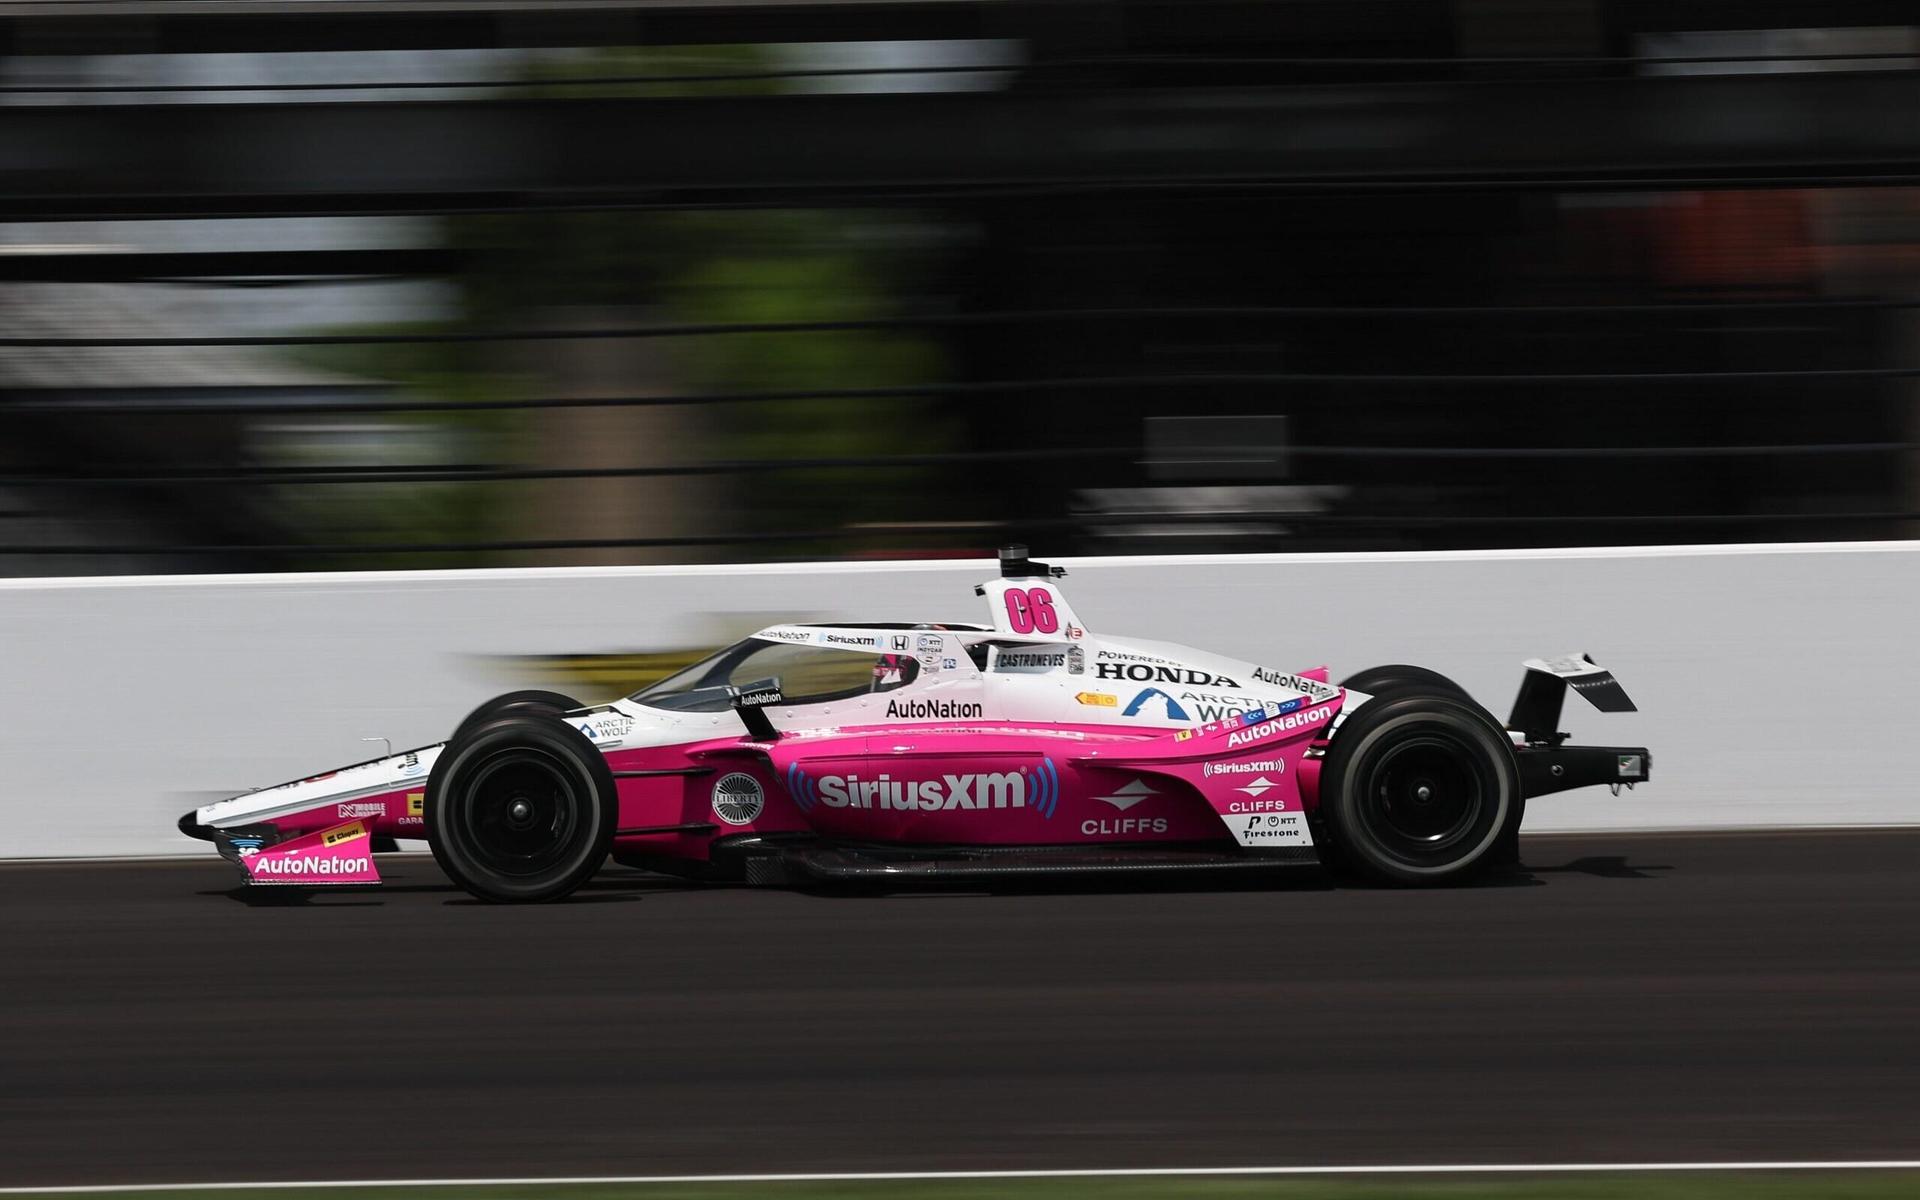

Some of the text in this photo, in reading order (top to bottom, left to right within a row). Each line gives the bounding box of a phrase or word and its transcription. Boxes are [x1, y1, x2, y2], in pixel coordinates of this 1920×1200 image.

[1003, 587, 1059, 635] 06
[1000, 653, 1066, 668] CASTRONEVES
[1098, 650, 1166, 664] POWERED
[1095, 662, 1242, 689] HONDA
[741, 692, 782, 706] AutoNation
[886, 699, 983, 719] AutoNation
[596, 718, 636, 728] ARCTIC
[1227, 705, 1332, 748] AutoNation
[600, 726, 632, 737] WOLF
[1229, 800, 1285, 812] CLIFFS
[1081, 818, 1168, 835] CLIFFS
[254, 856, 369, 874] AutoNation
